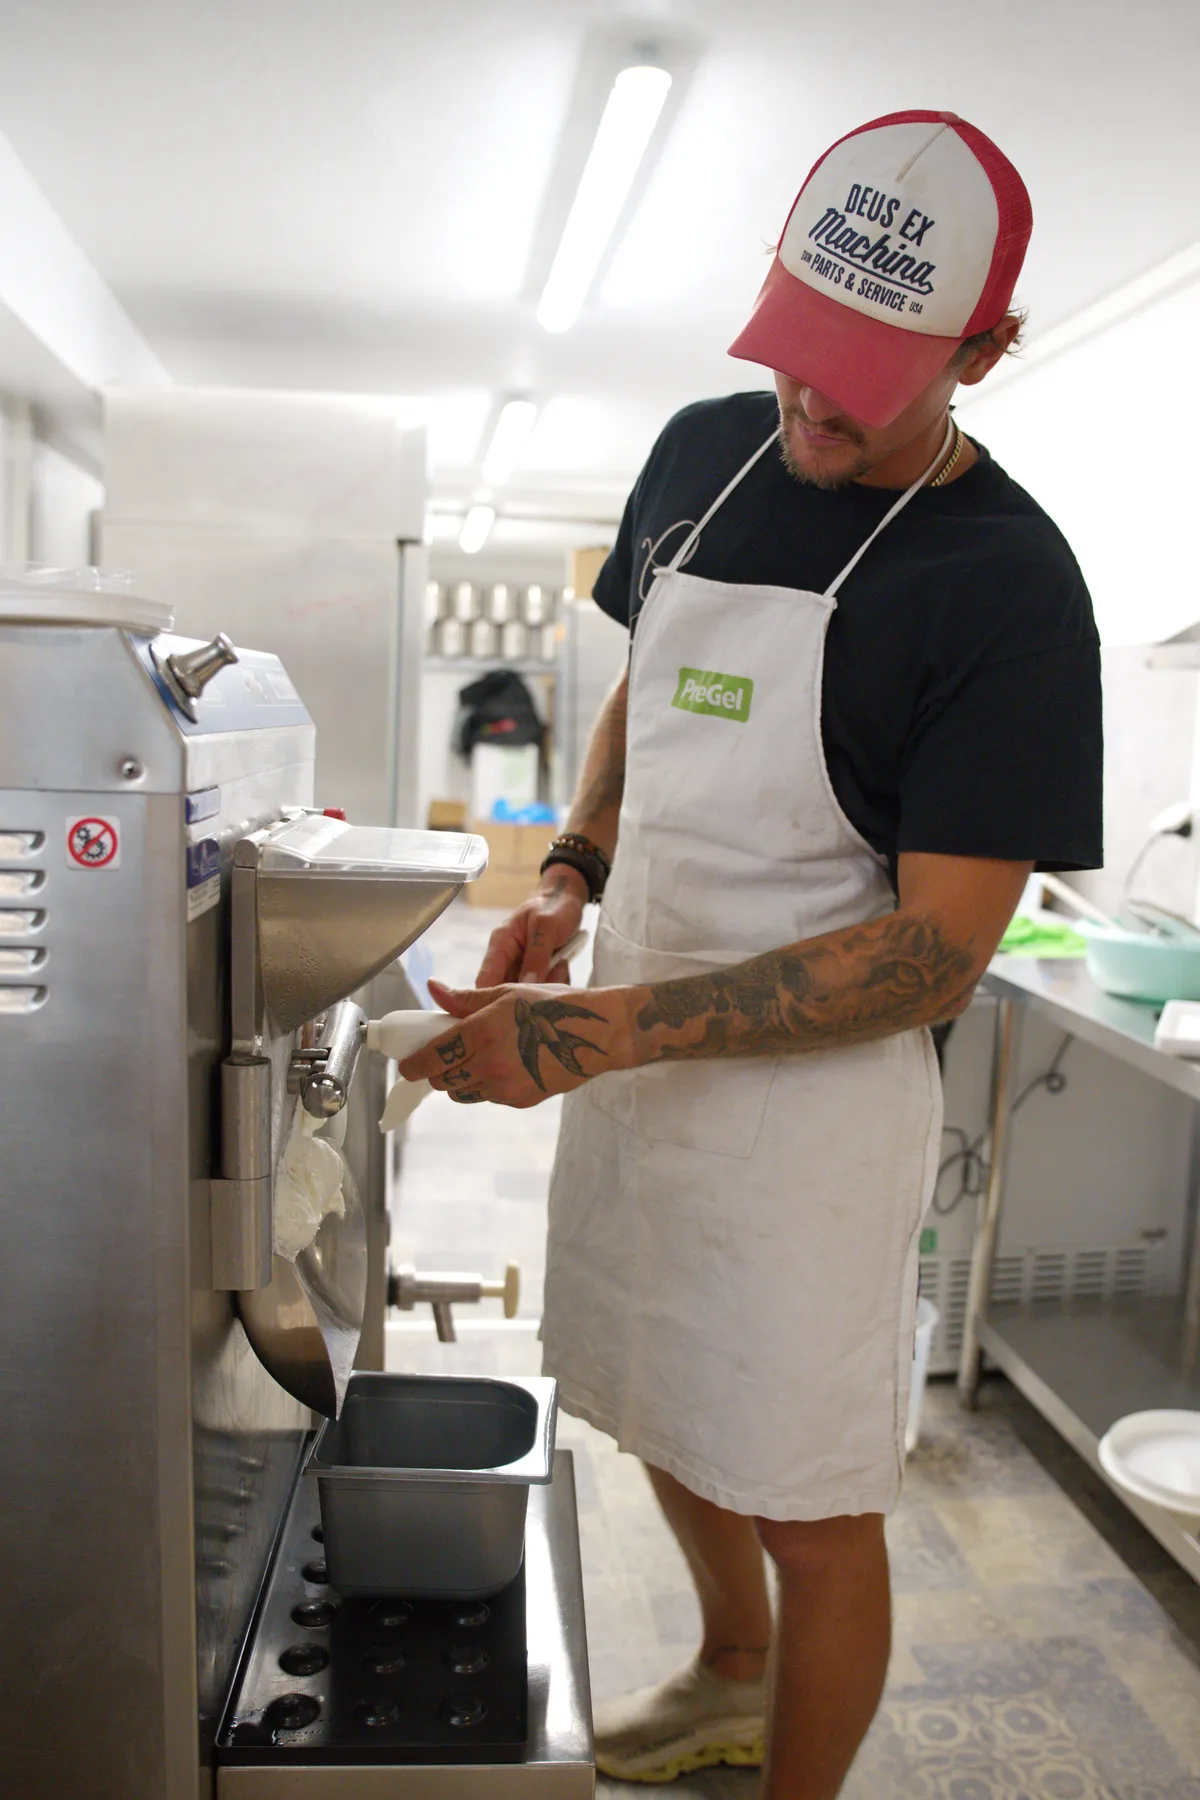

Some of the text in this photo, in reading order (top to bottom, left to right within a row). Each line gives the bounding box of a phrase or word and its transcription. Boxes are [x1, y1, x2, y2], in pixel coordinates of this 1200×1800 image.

[844, 183, 935, 247] DEUS EX
[808, 207, 936, 295] Machina
[810, 253, 845, 284] PARTS
[844, 272, 856, 291] &
[857, 278, 908, 312] SERVICE
[909, 301, 923, 314] USA
[680, 678, 744, 711] PreGel
